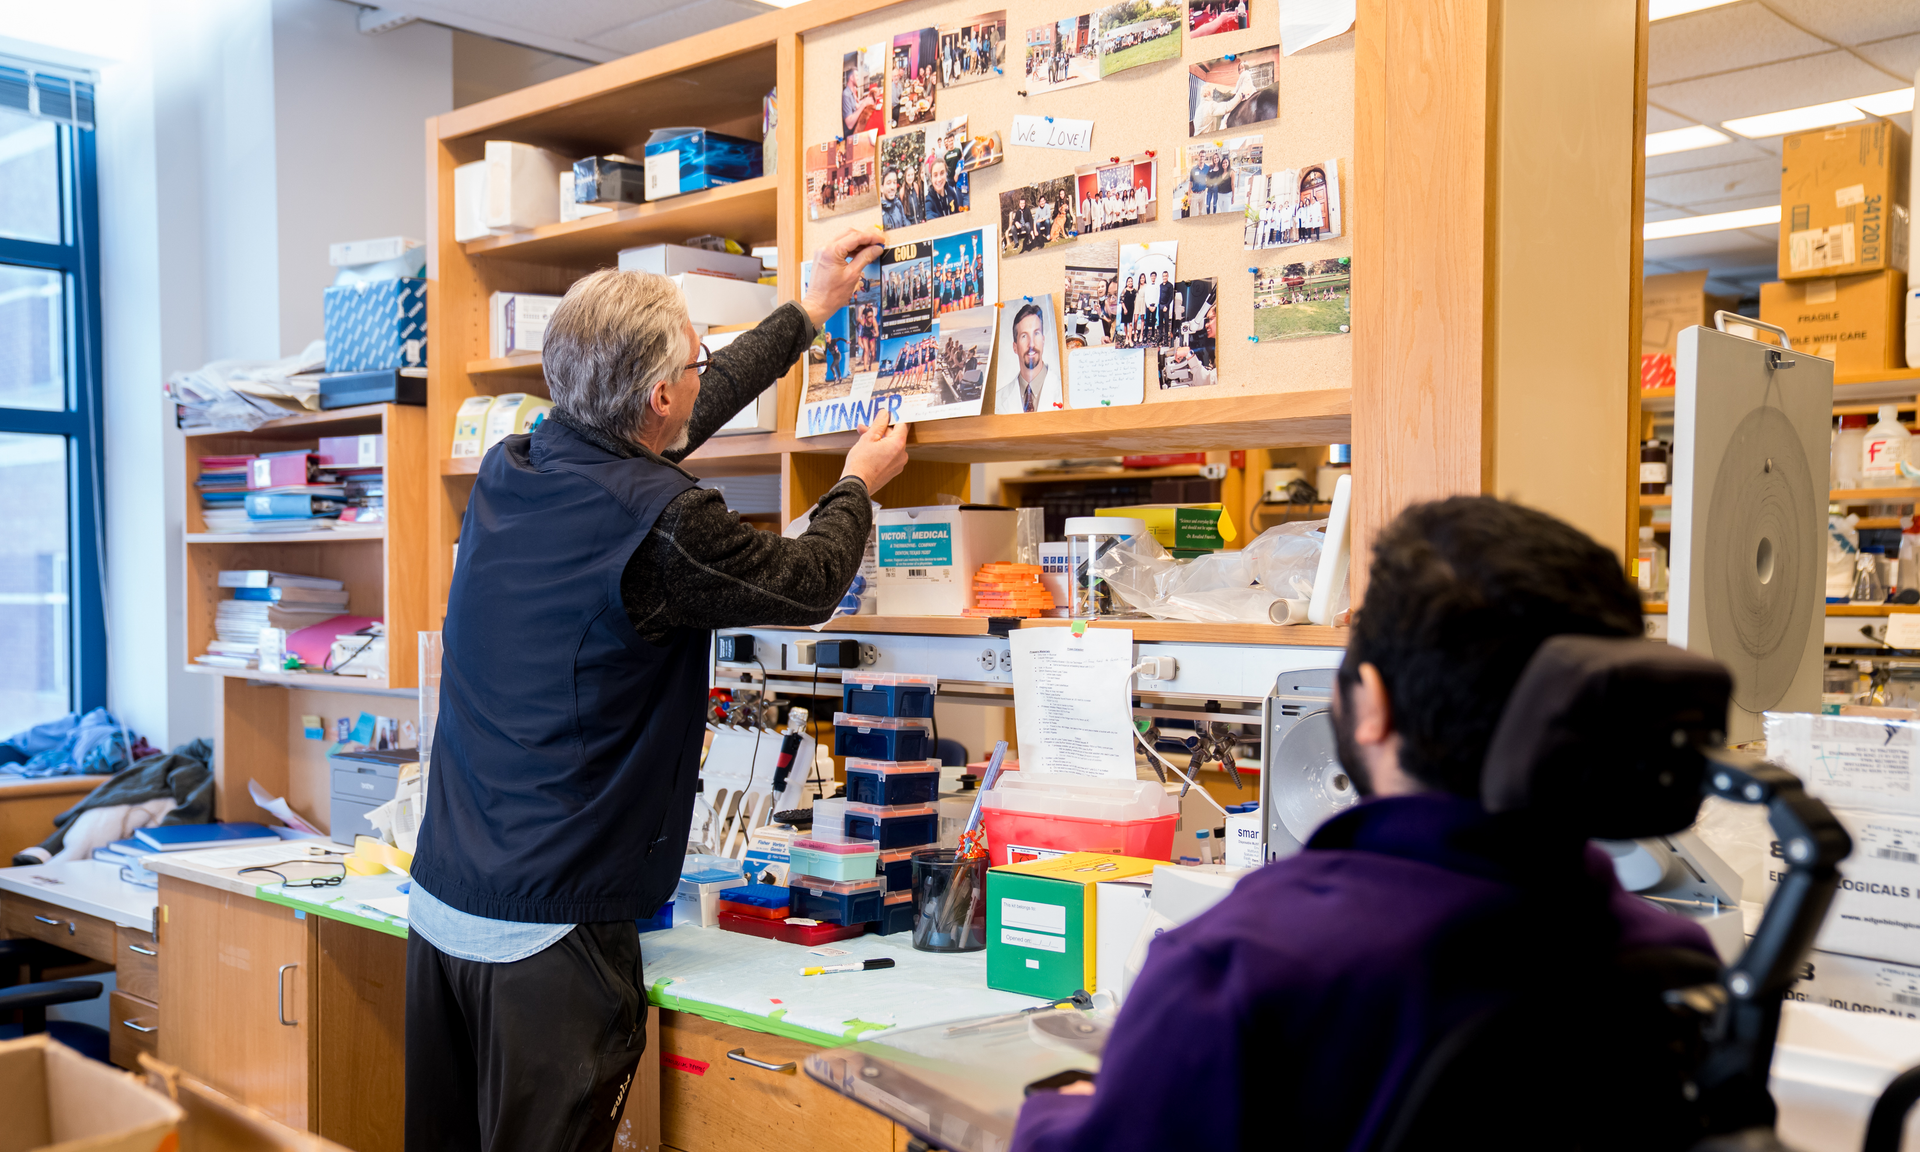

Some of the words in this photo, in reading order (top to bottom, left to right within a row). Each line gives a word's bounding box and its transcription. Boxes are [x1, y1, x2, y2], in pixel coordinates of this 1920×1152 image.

[1017, 121, 1036, 143] We
[894, 243, 918, 262] GOLD
[1798, 311, 1840, 323] FRAGILE
[1813, 332, 1838, 342] WITH
[1840, 330, 1867, 342] CARE
[881, 532, 906, 540] VICTOR
[912, 530, 948, 539] MEDICAL
[1005, 934, 1024, 943] Opened
